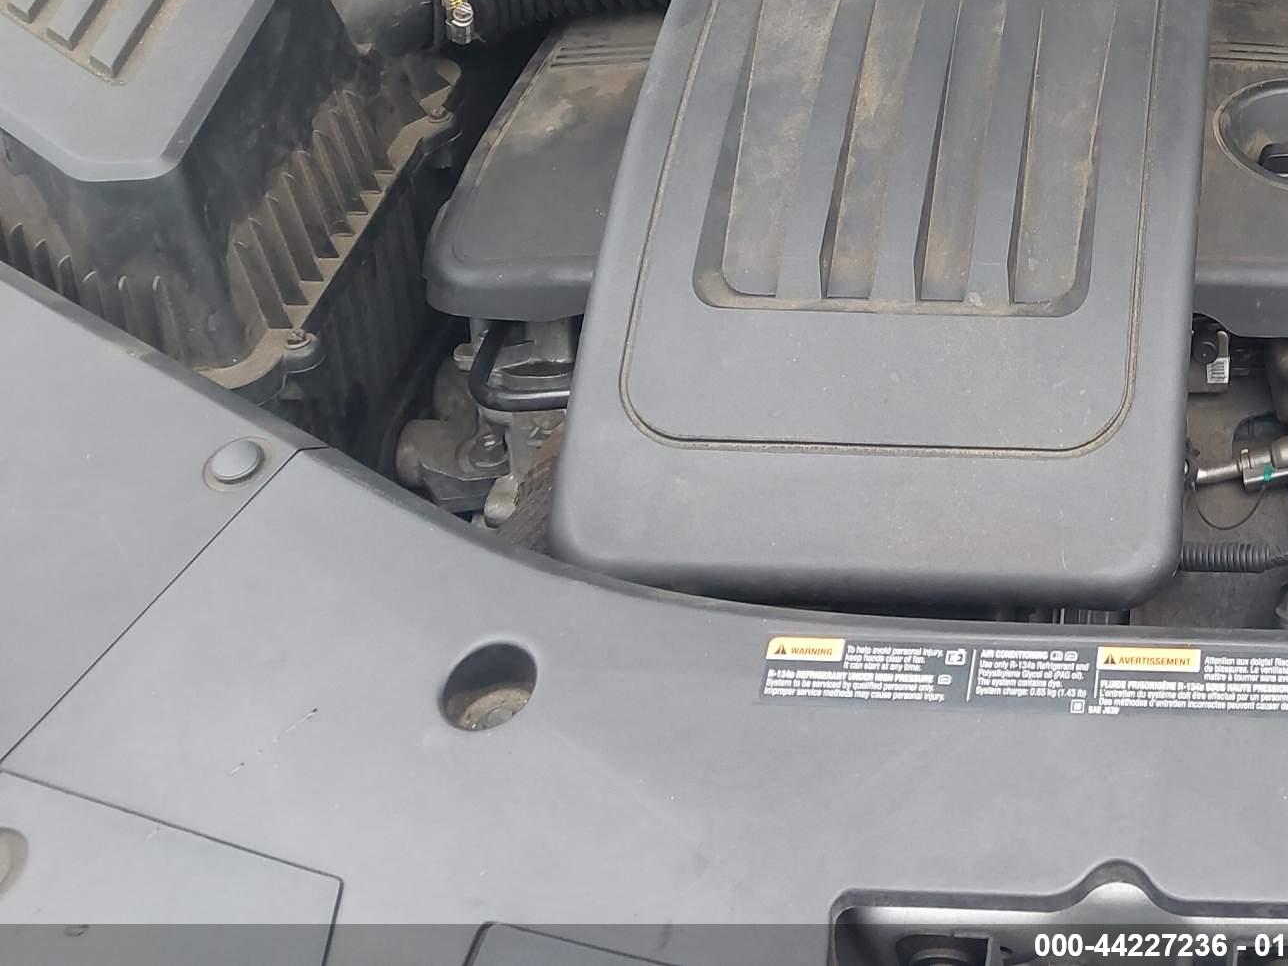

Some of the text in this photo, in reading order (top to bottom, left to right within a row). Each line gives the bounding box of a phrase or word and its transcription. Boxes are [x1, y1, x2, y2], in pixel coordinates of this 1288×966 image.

[790, 646, 833, 657] WARNING
[892, 648, 922, 657] personal
[980, 660, 1089, 671] Use only R-134a Refrigerant and
[1118, 657, 1191, 666] AVERTISSEMENT
[889, 664, 903, 672] any
[766, 679, 792, 688] System
[793, 679, 800, 687] to
[801, 680, 811, 688] be
[991, 678, 1016, 687] system
[854, 691, 870, 700] may
[892, 692, 923, 701] personal
[1047, 689, 1056, 698] kg
